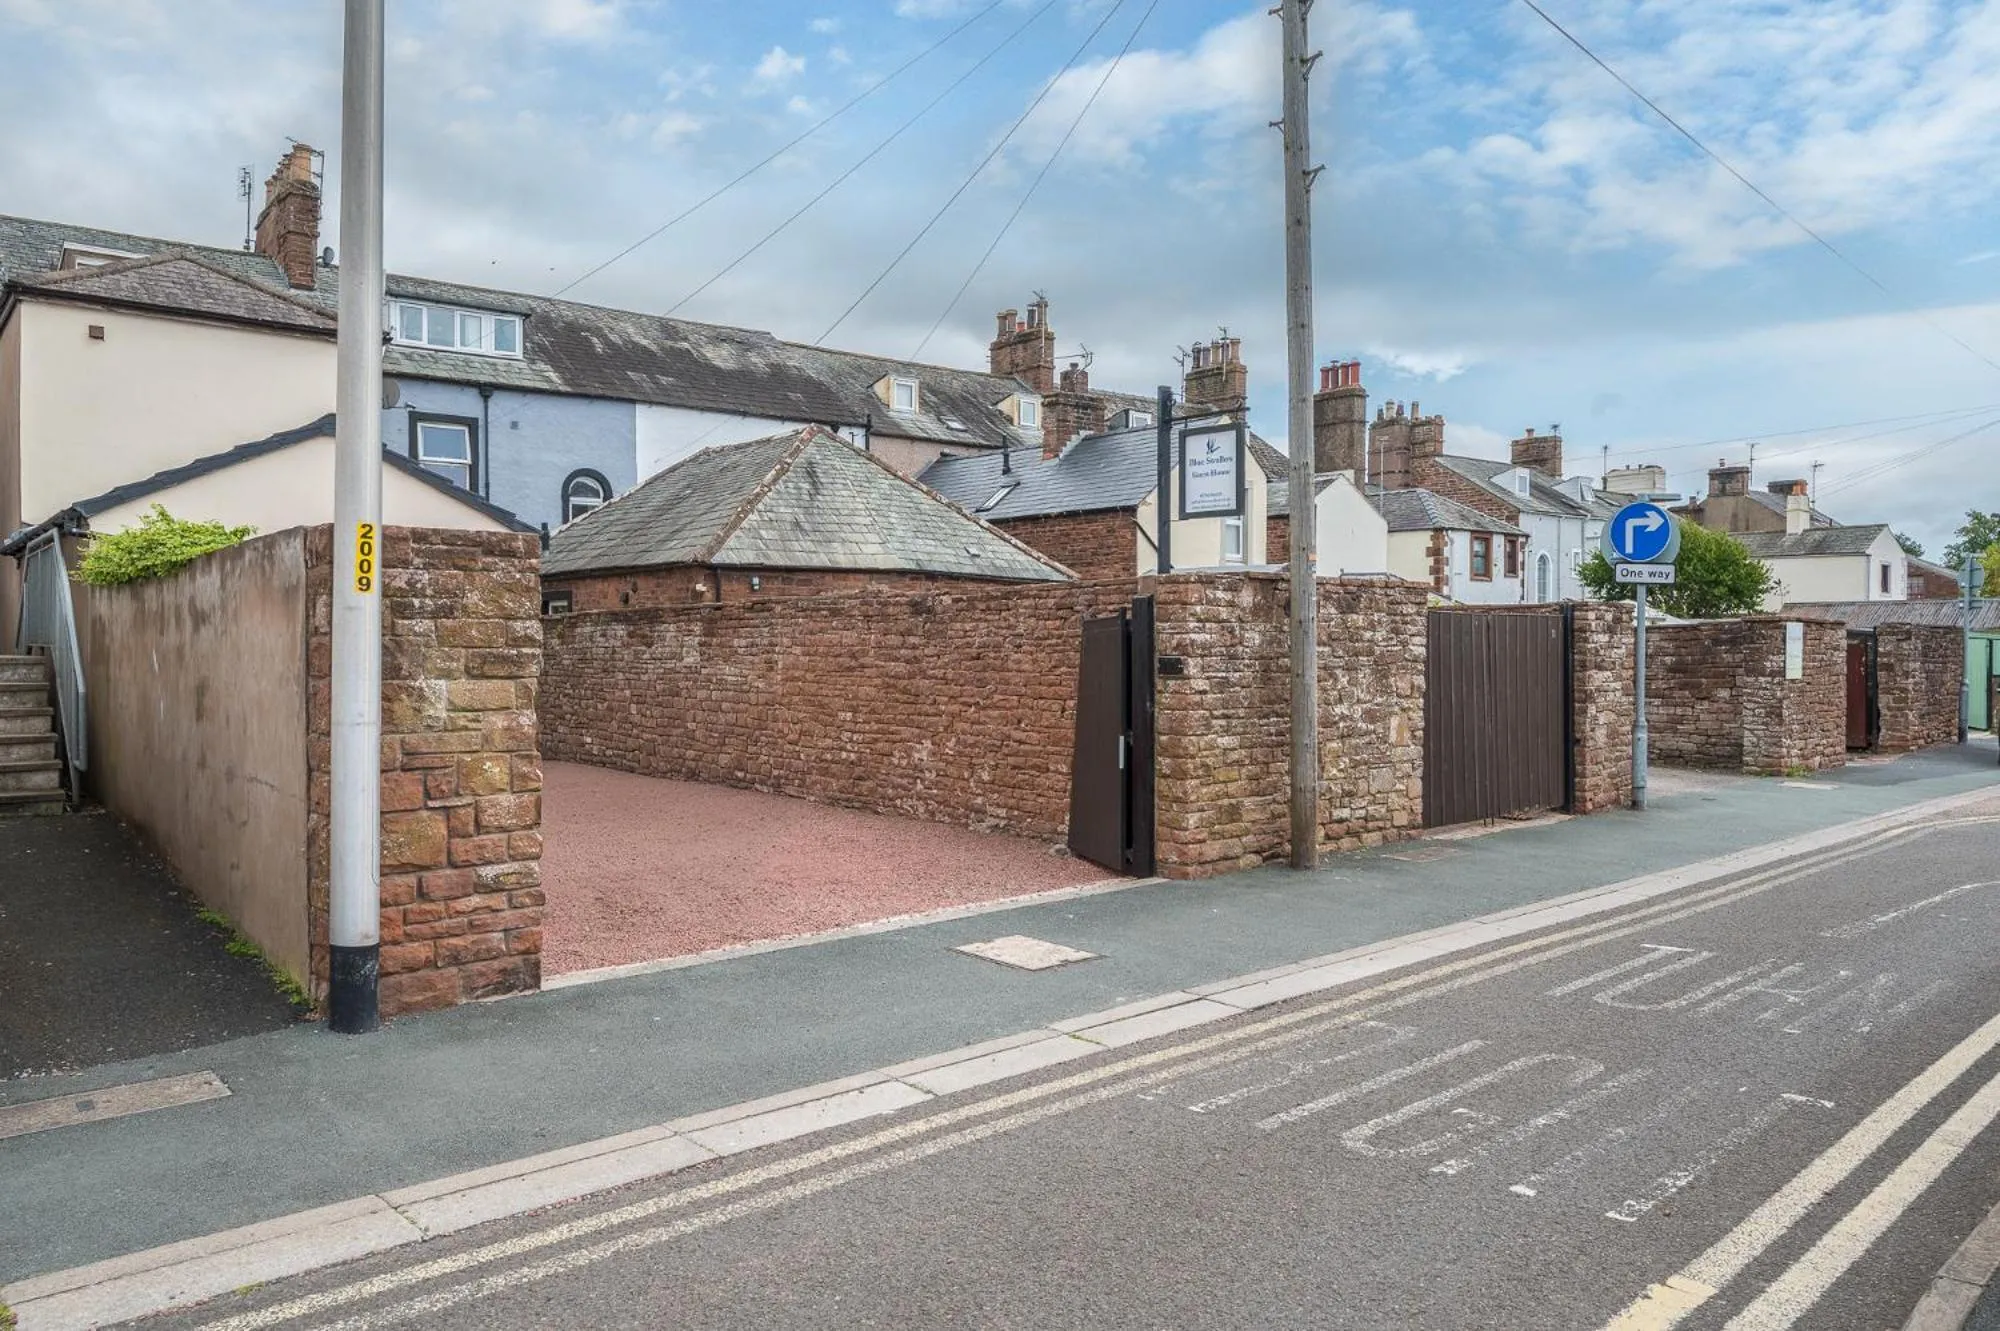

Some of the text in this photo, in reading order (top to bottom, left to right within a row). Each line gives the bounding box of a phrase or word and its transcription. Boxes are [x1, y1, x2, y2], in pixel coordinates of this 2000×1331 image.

[1189, 458, 1205, 467] Blue
[358, 523, 373, 592] 2009
[1620, 567, 1671, 580] One way
